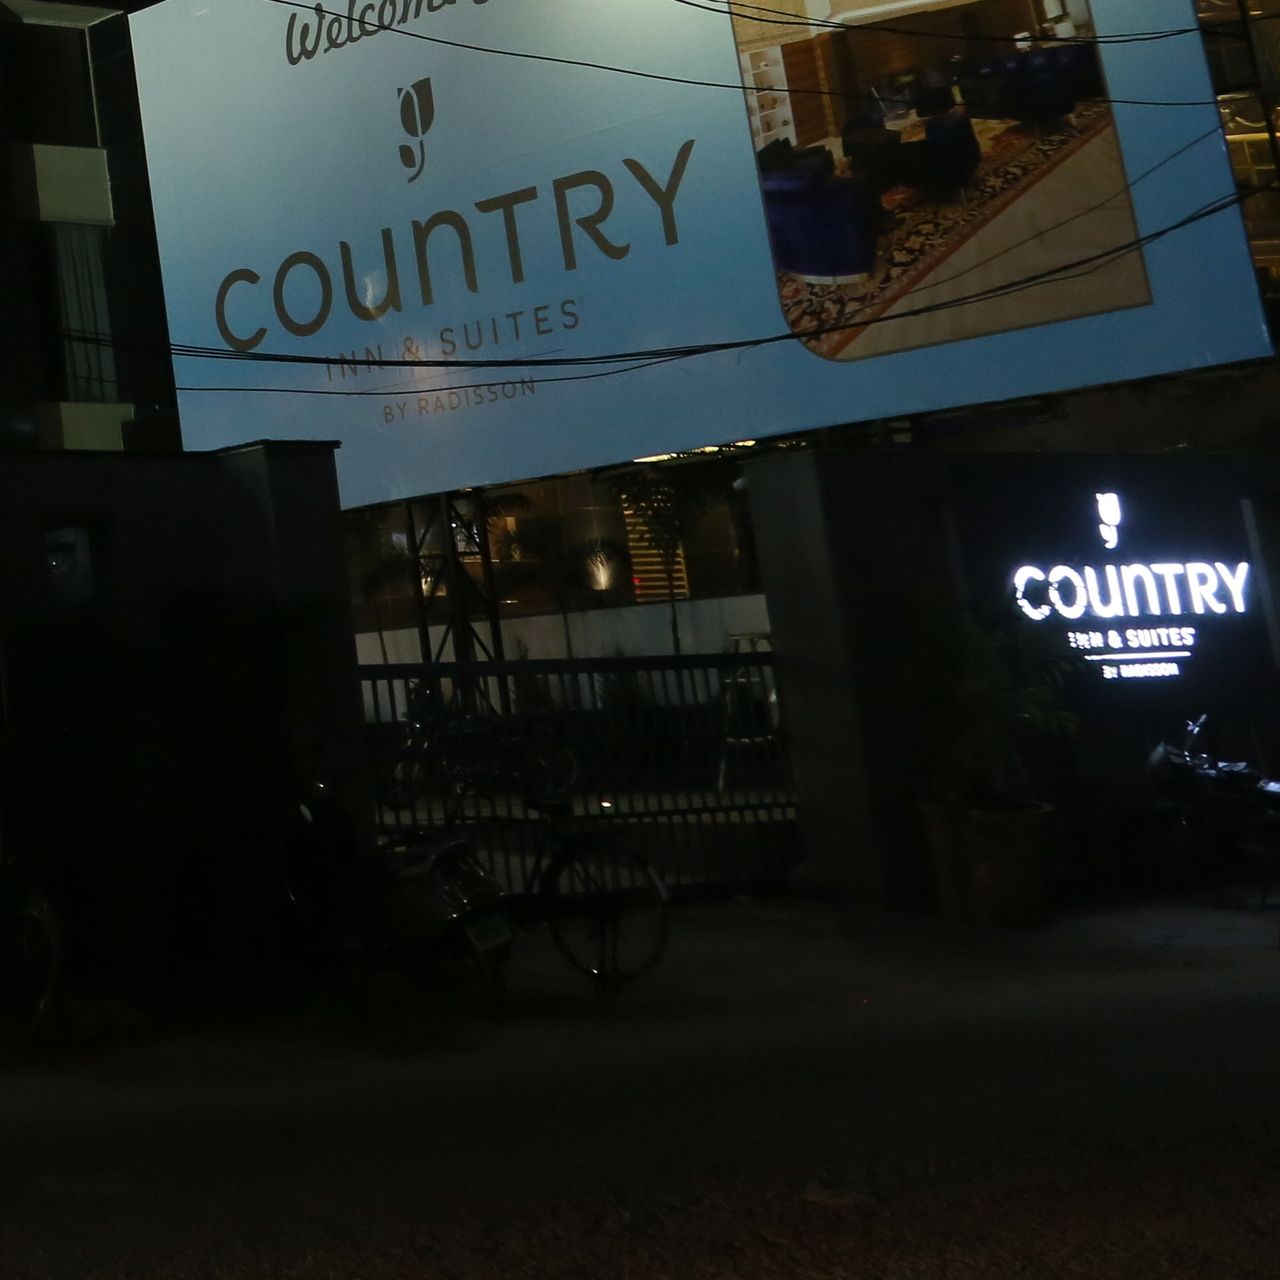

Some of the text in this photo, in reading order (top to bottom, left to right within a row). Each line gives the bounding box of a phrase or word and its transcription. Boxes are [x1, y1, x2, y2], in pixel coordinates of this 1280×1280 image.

[215, 139, 696, 352] COUNTRY
[325, 299, 580, 382] INN & SUITES
[383, 376, 536, 424] BY RADISSON
[1014, 562, 1249, 620] COUNTRY
[1108, 630, 1123, 648] &
[1126, 627, 1195, 648] SUITES
